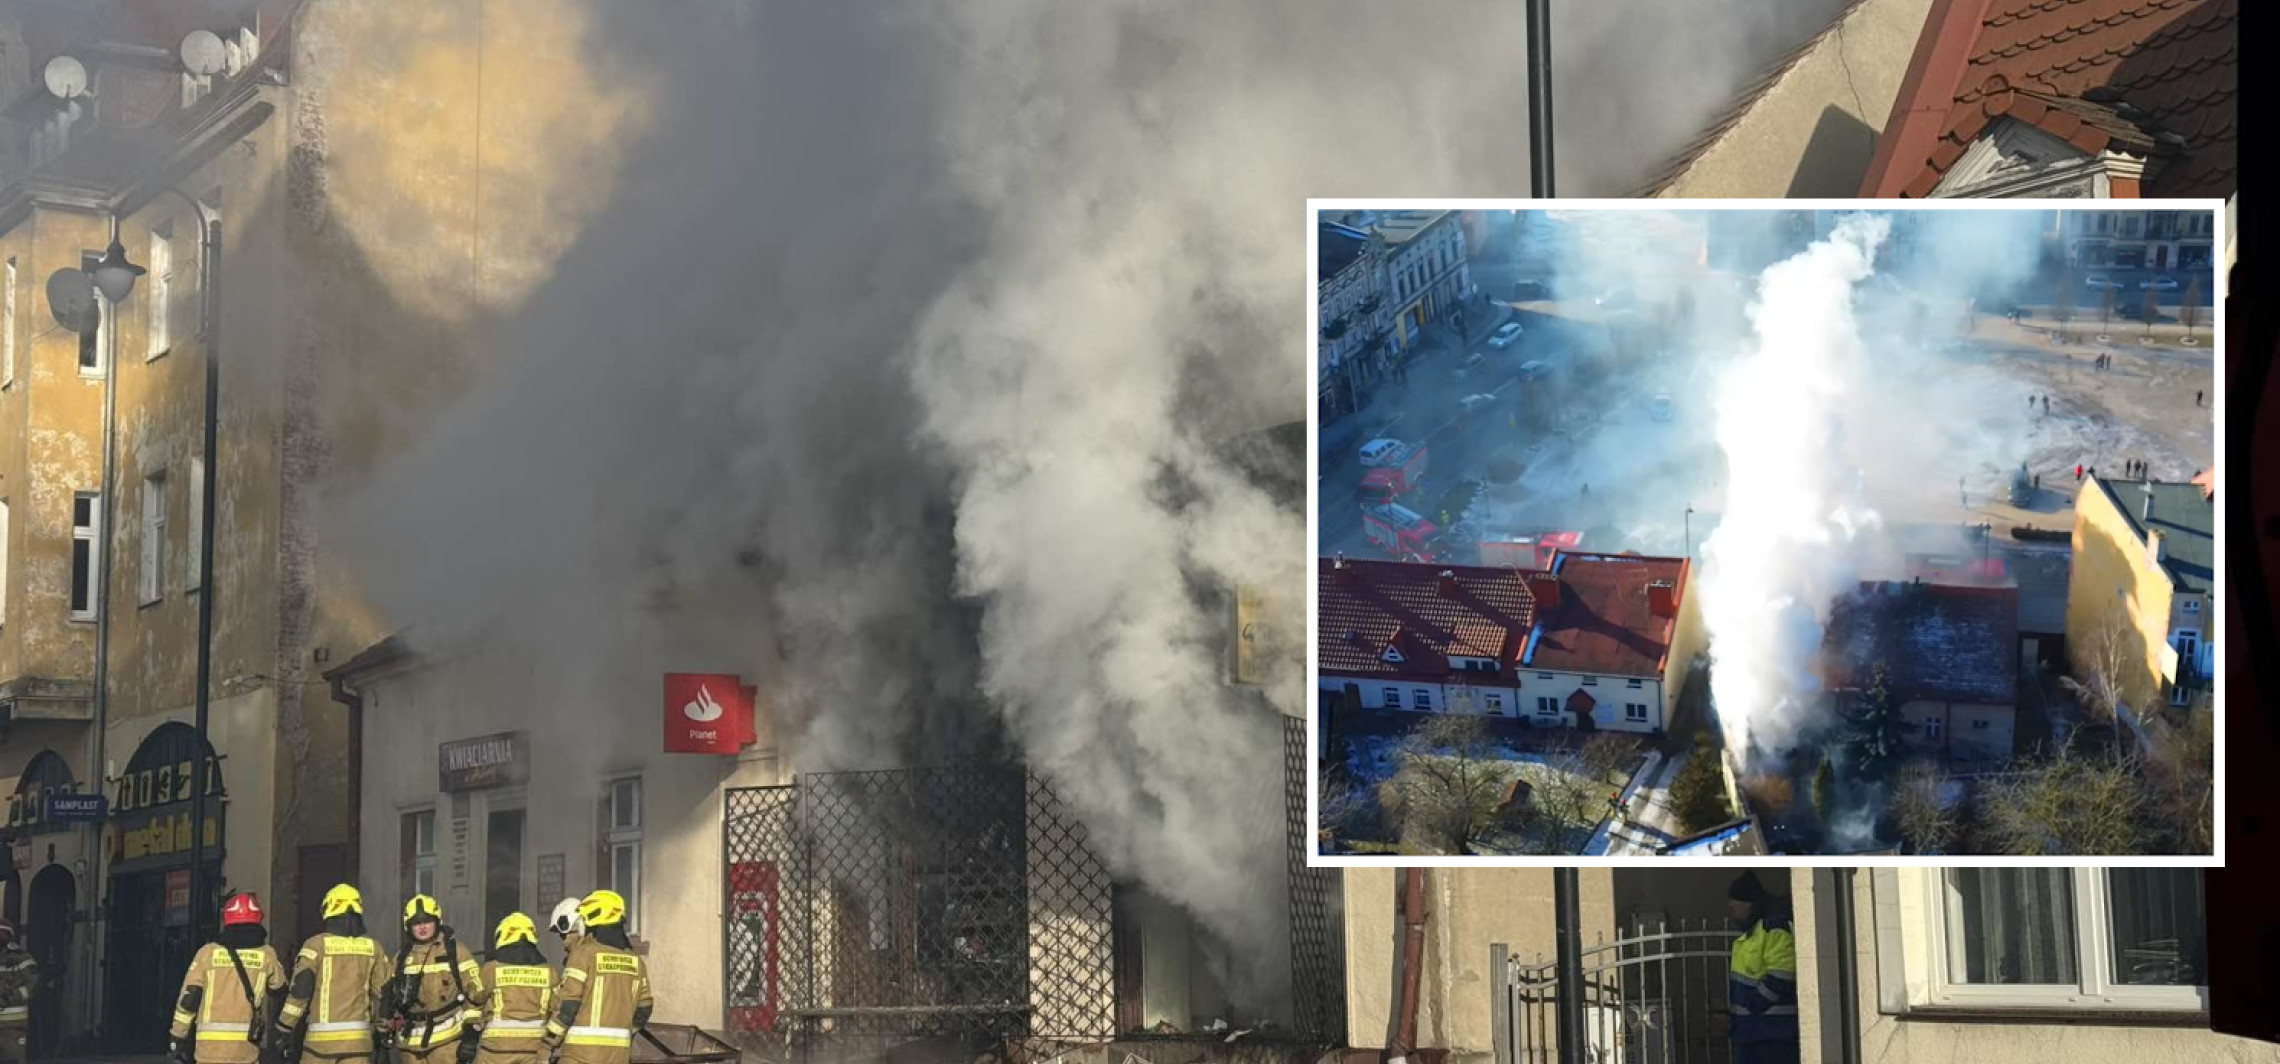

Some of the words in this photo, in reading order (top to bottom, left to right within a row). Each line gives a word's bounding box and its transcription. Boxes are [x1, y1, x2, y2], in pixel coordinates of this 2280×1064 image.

[689, 729, 717, 740] Planet
[449, 739, 512, 772] KWIACIARNIA
[54, 800, 99, 810] SANPLAST
